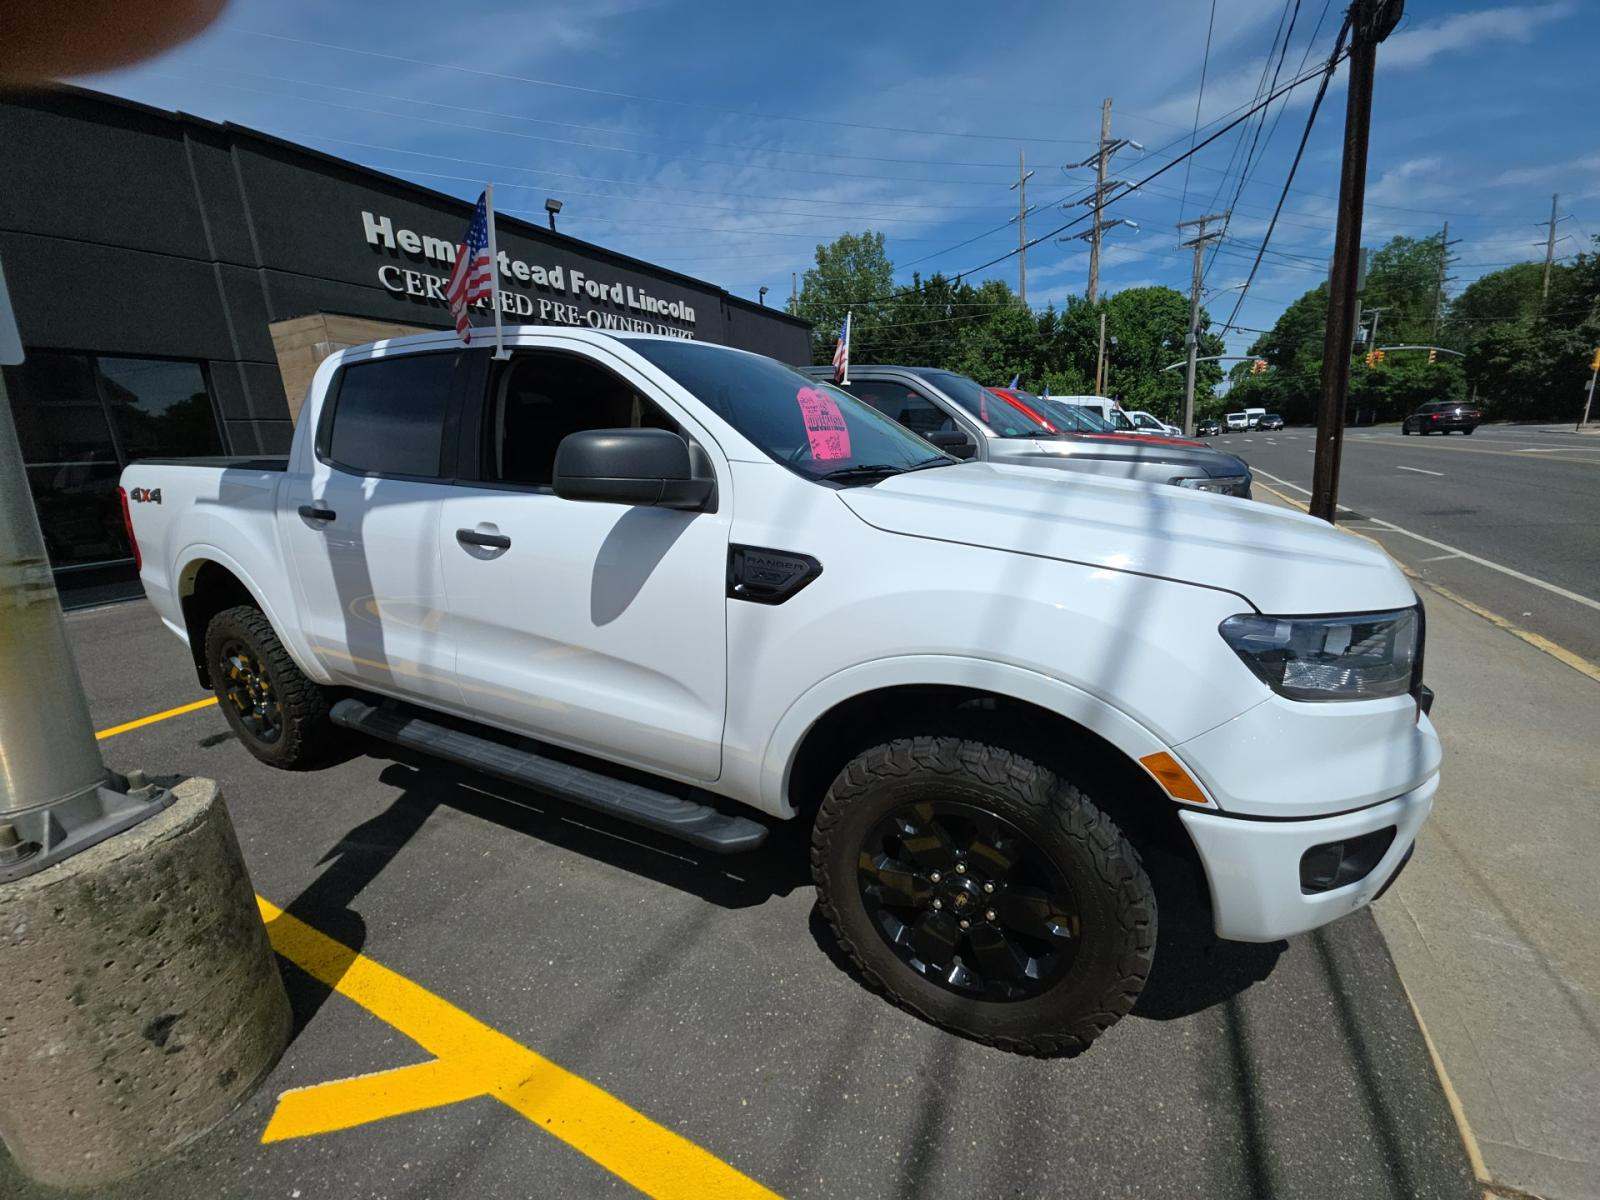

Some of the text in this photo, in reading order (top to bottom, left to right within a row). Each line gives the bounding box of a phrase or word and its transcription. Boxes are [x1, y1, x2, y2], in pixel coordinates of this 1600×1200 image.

[361, 211, 696, 322] Hemtead Ford Lincoln
[537, 298, 655, 336] PRE-OWNED
[746, 556, 804, 570] RANGER
